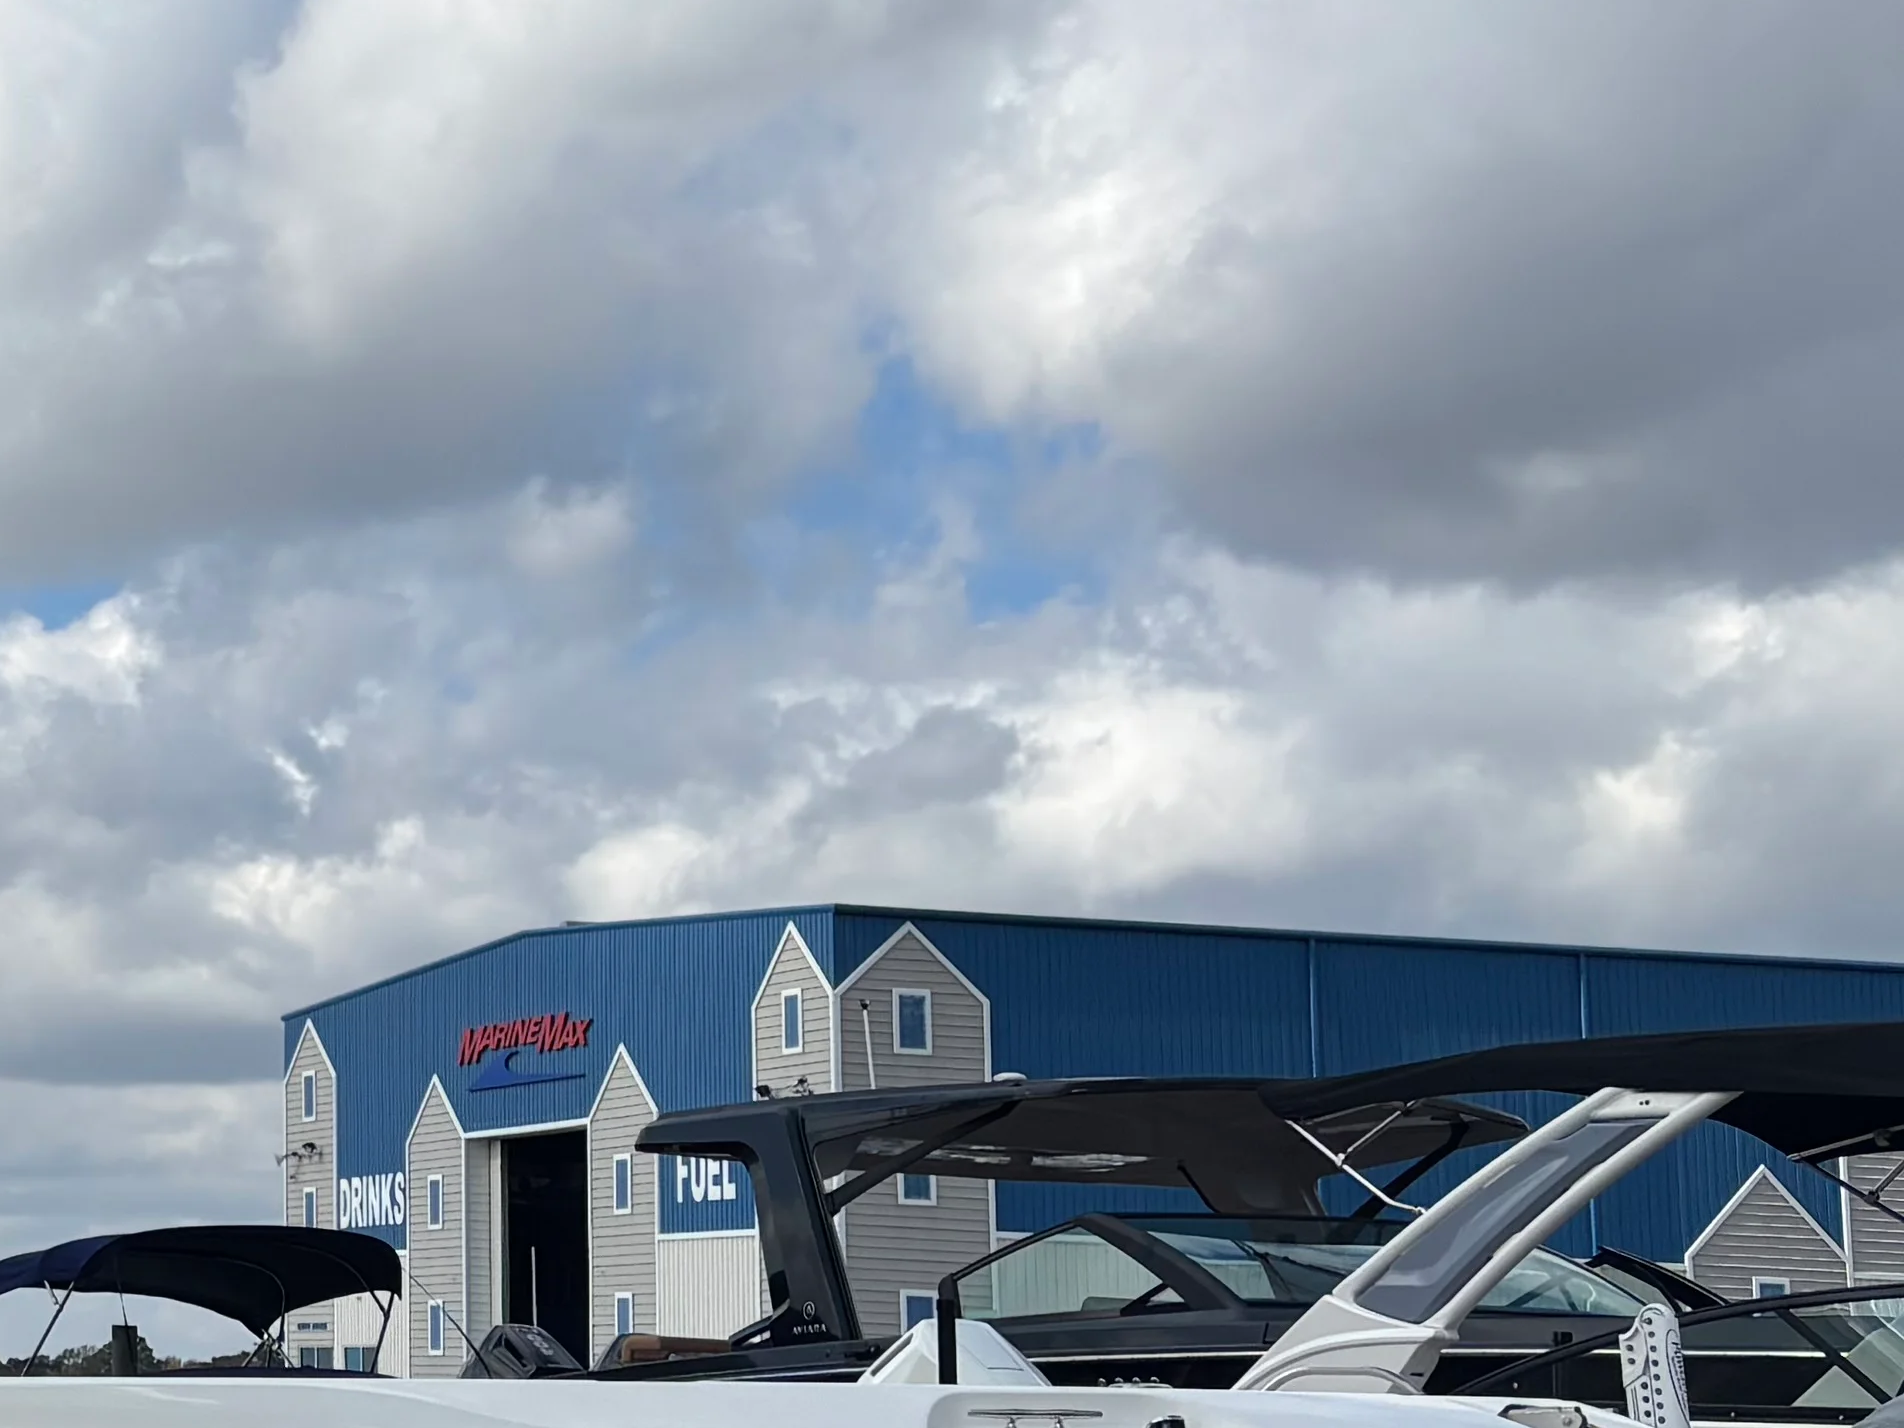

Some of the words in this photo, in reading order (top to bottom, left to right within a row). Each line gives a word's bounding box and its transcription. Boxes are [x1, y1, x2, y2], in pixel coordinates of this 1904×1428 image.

[339, 1172, 405, 1230] DRINKS
[676, 1155, 736, 1204] FUEL
[793, 1323, 827, 1335] AVIARA
